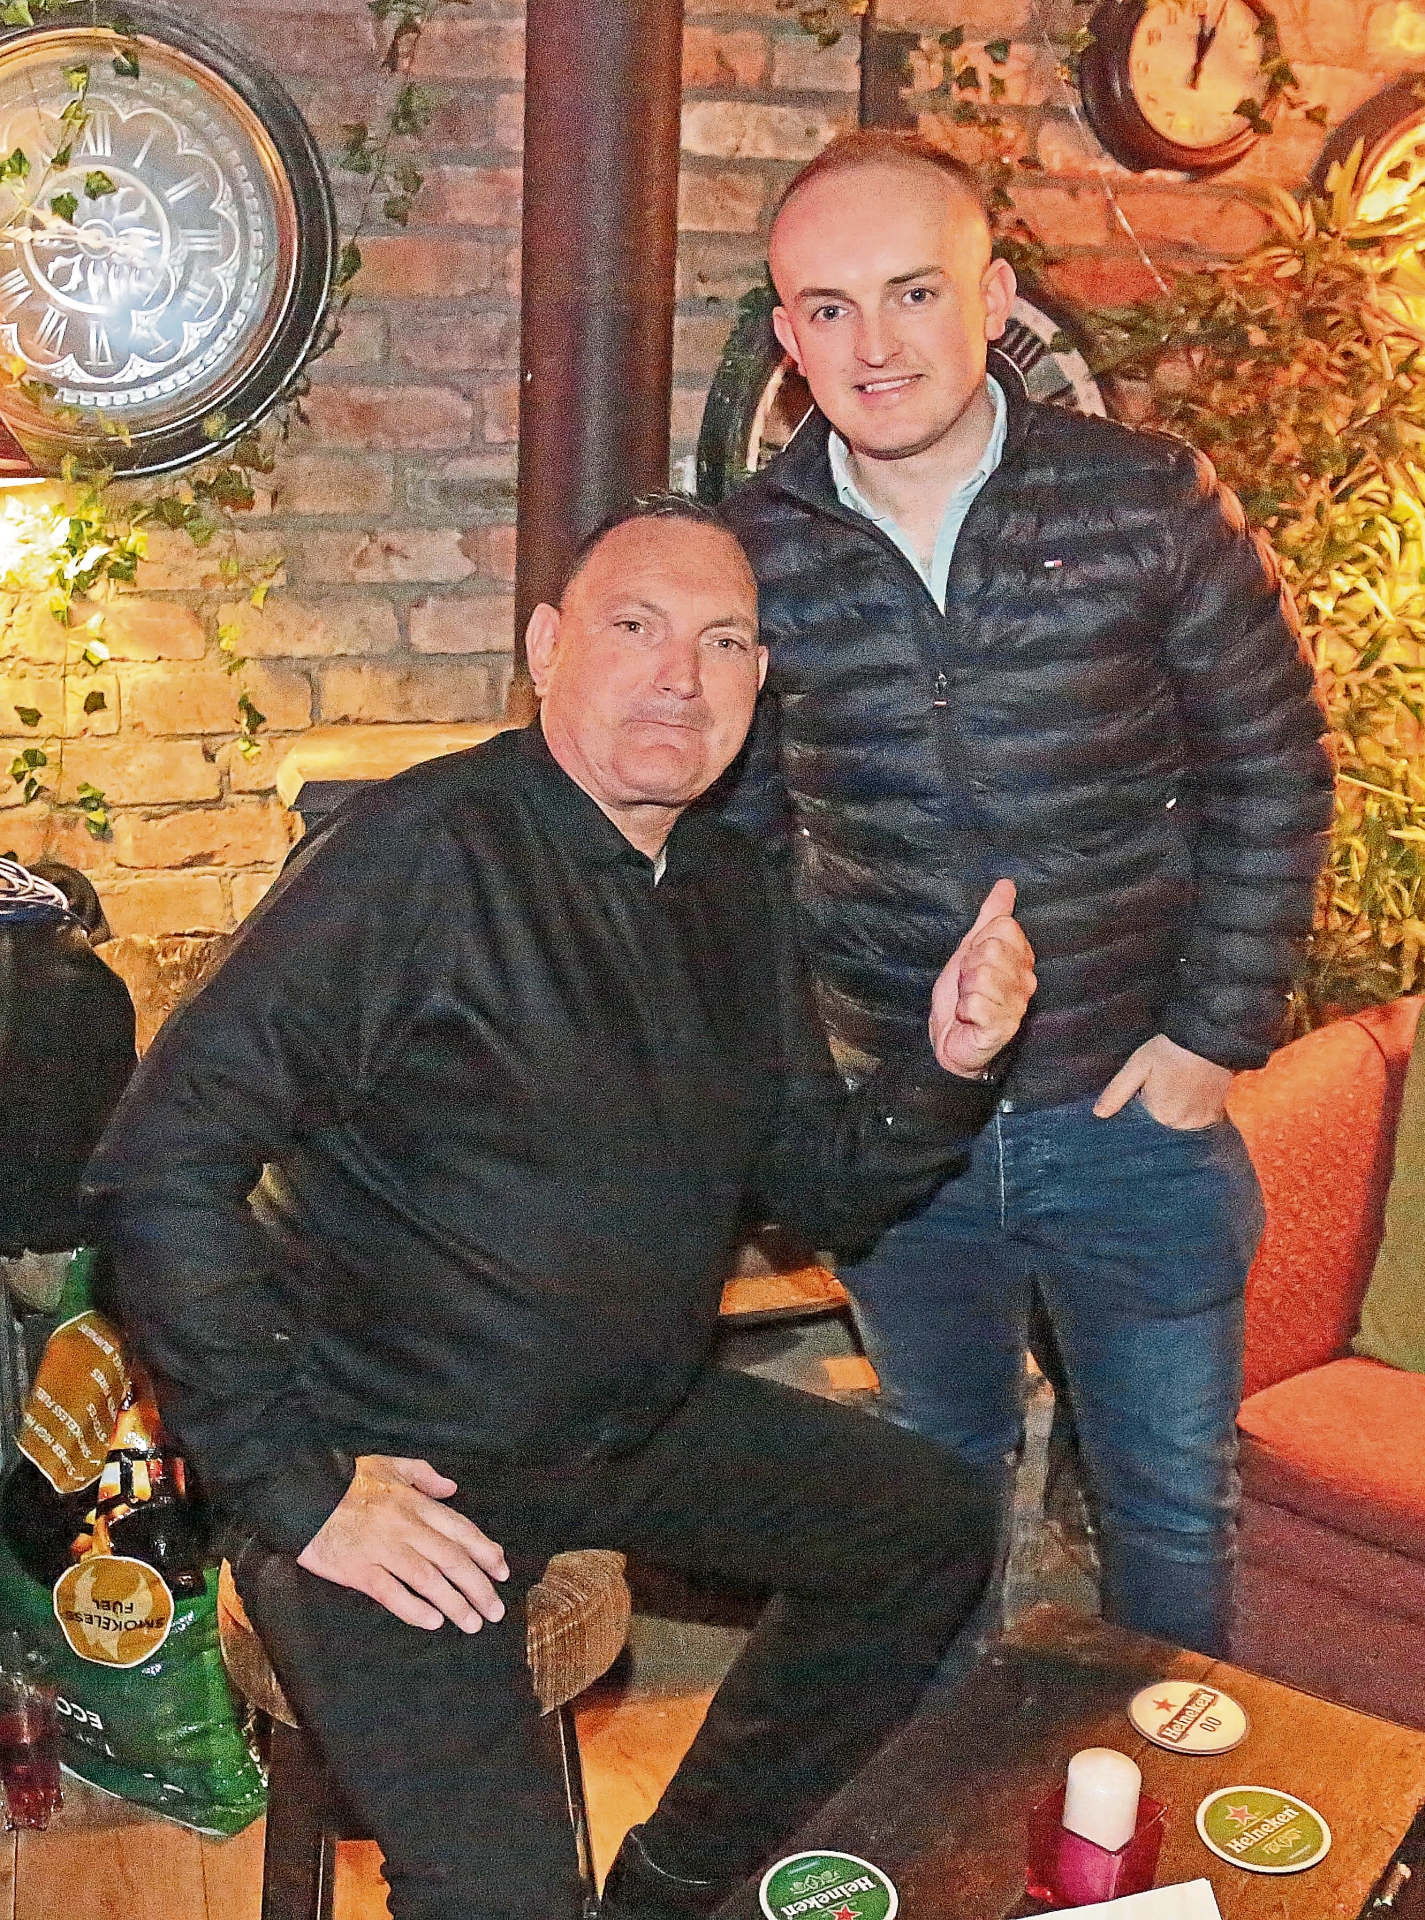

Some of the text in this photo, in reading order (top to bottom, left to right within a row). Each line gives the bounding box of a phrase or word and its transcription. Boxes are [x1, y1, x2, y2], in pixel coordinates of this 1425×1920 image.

[64, 1609, 166, 1632] SMOKELESS
[91, 1598, 134, 1614] FUEL
[1161, 1689, 1216, 1740] Heineken
[1225, 1807, 1300, 1855] Heineken
[780, 1875, 877, 1917] Heineken
